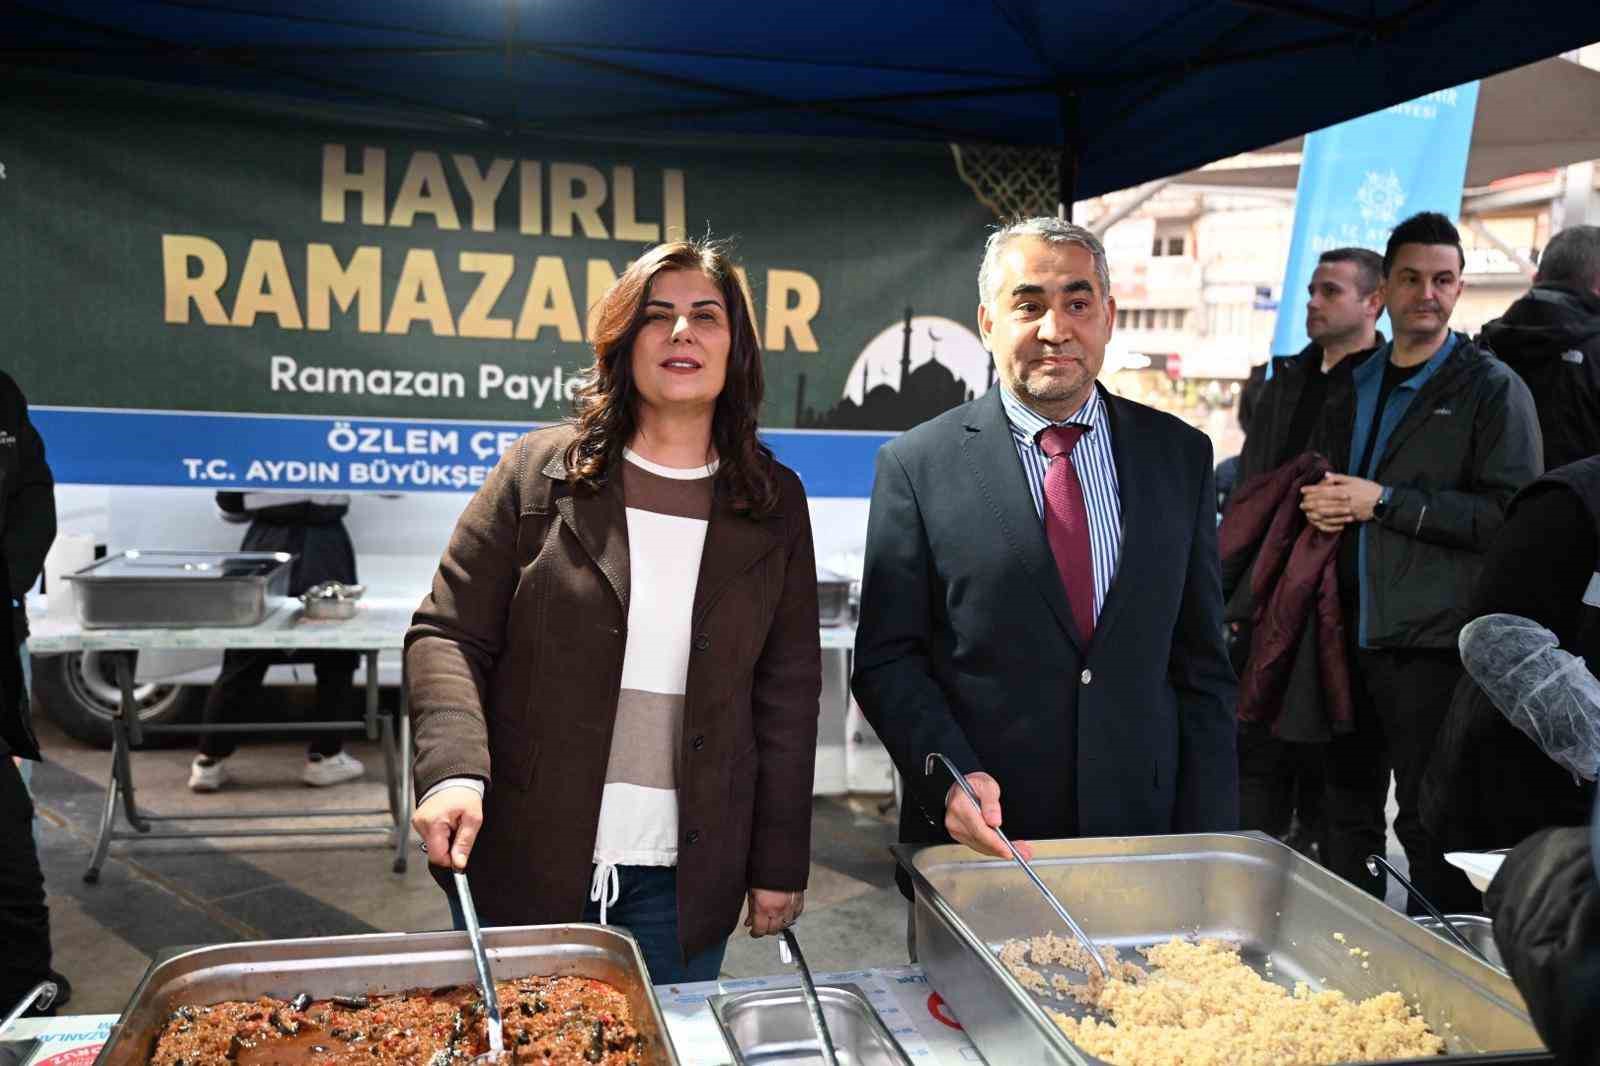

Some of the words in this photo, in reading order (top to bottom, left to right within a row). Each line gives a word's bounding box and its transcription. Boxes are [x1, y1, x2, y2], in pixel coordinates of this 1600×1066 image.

[321, 143, 687, 243] HAYIRLI
[162, 234, 821, 352] RAMAZAR
[270, 356, 465, 398] Ramazan
[327, 422, 459, 455] ÖZLEM
[470, 430, 527, 460] ÇE
[183, 458, 236, 480] T.C.
[246, 460, 340, 483] AYDIN
[349, 460, 495, 489] BÜYÜKŞE
